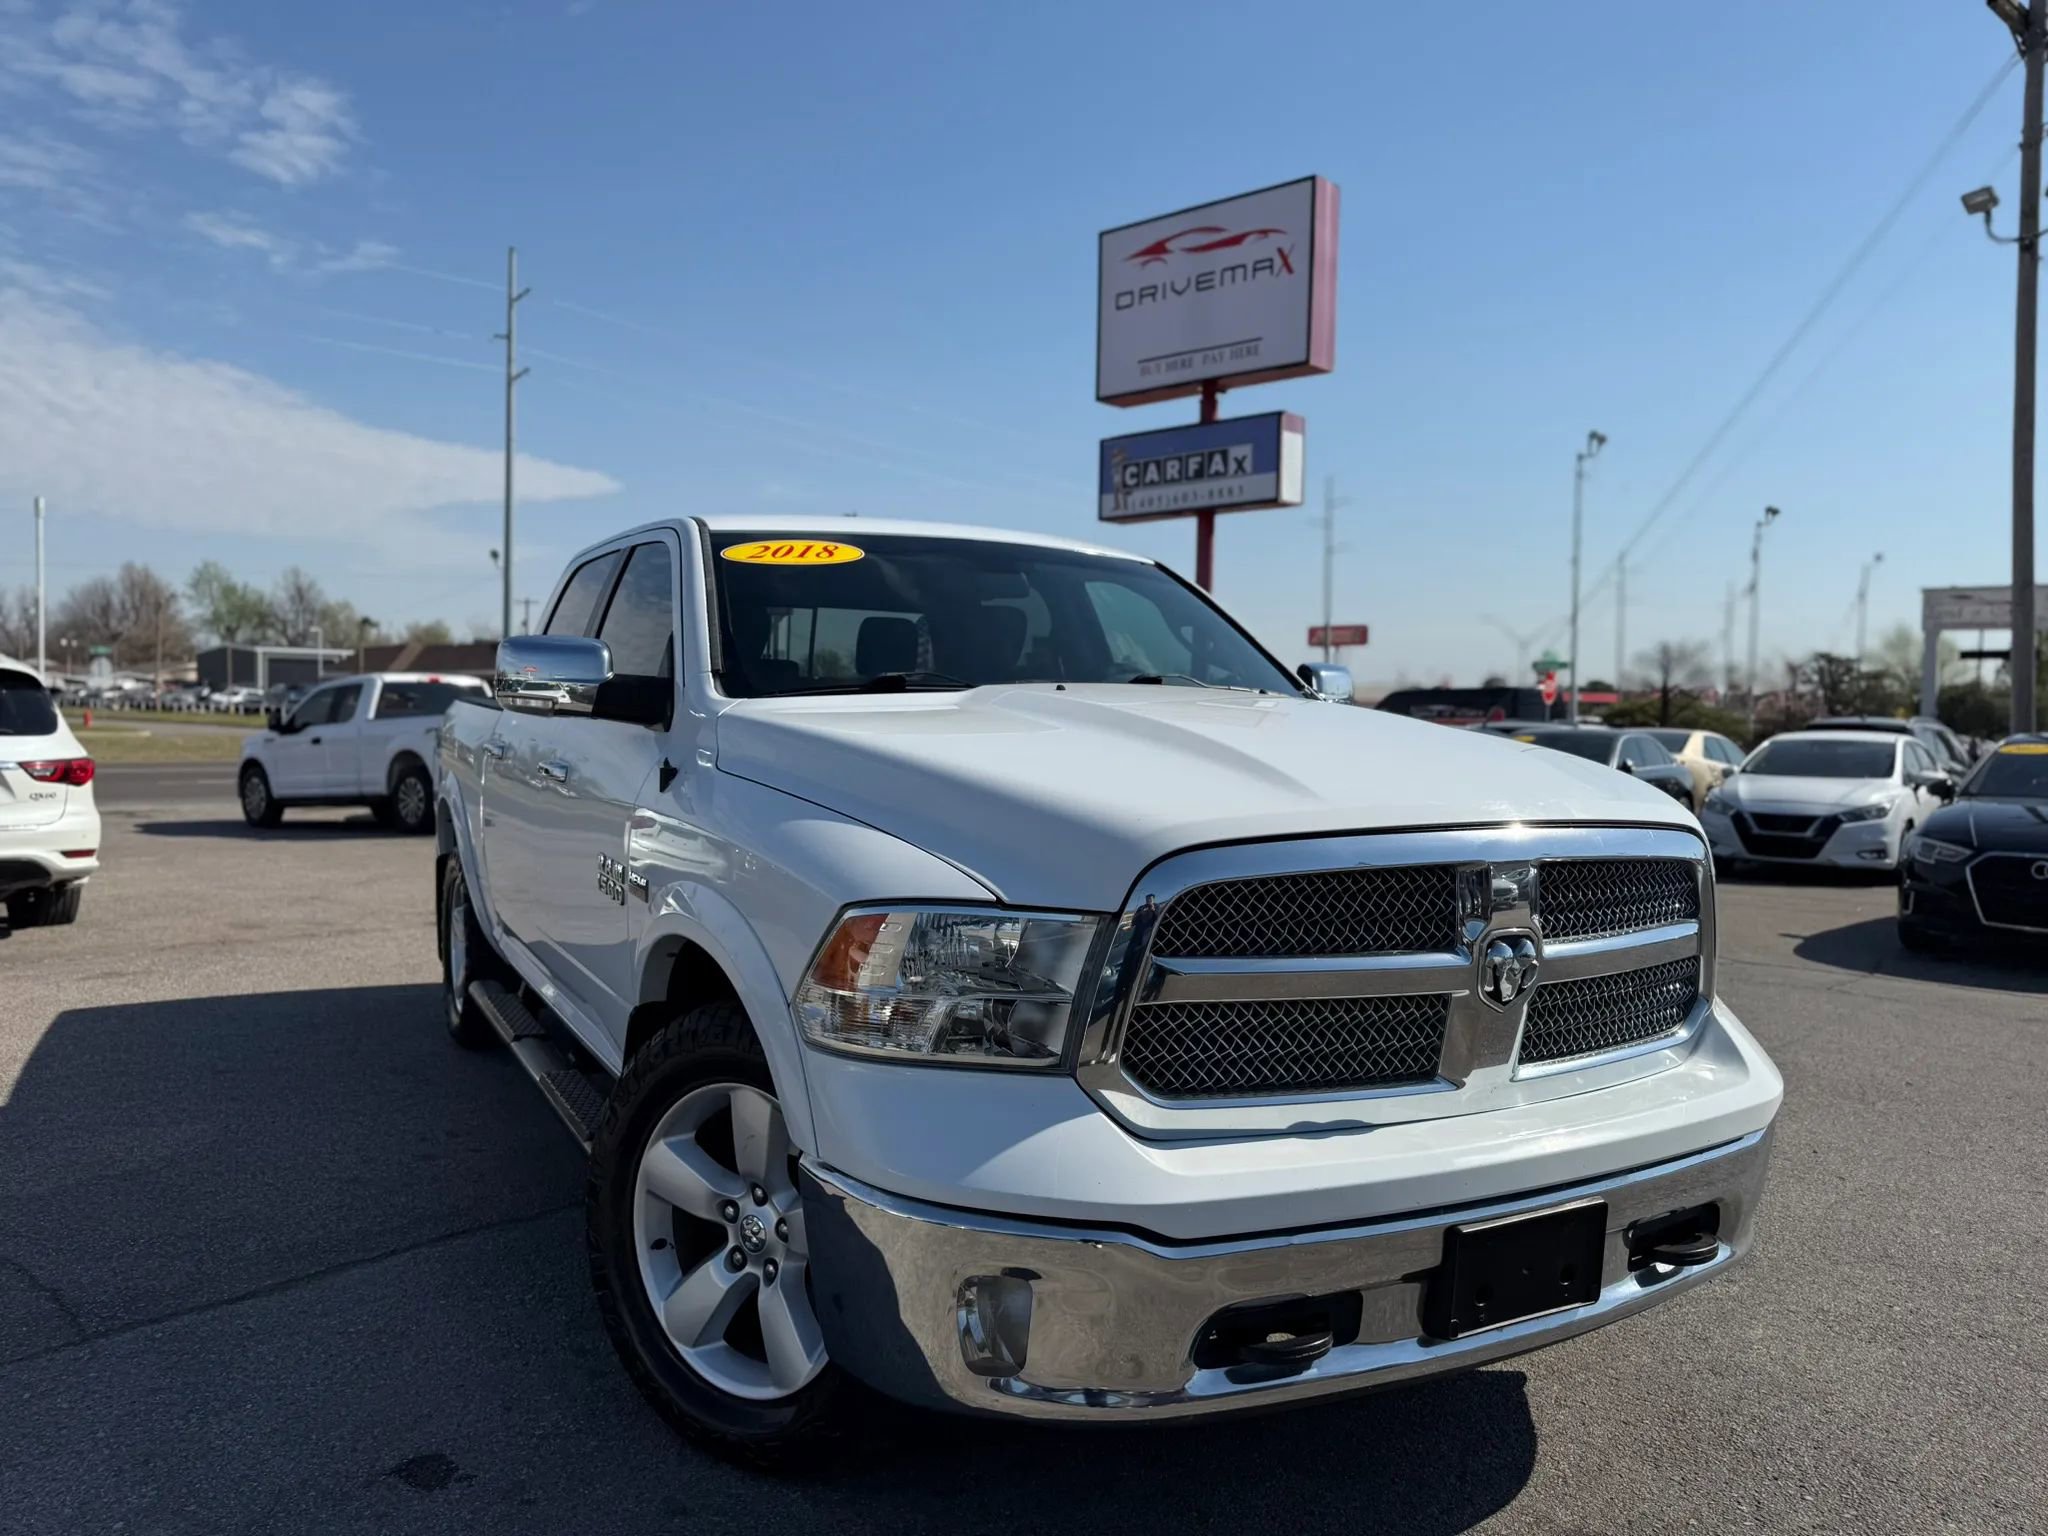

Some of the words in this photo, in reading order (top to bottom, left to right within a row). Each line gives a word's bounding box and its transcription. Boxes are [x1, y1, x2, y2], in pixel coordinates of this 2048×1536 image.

[1115, 244, 1295, 311] DRIVEMAX
[1165, 356, 1194, 373] HERE
[1202, 350, 1226, 366] PAY
[1230, 343, 1260, 361] HERE
[1123, 449, 1249, 488] CARFAX
[746, 543, 839, 559] 2018
[598, 852, 625, 886] RAM
[597, 872, 625, 906] 1500
